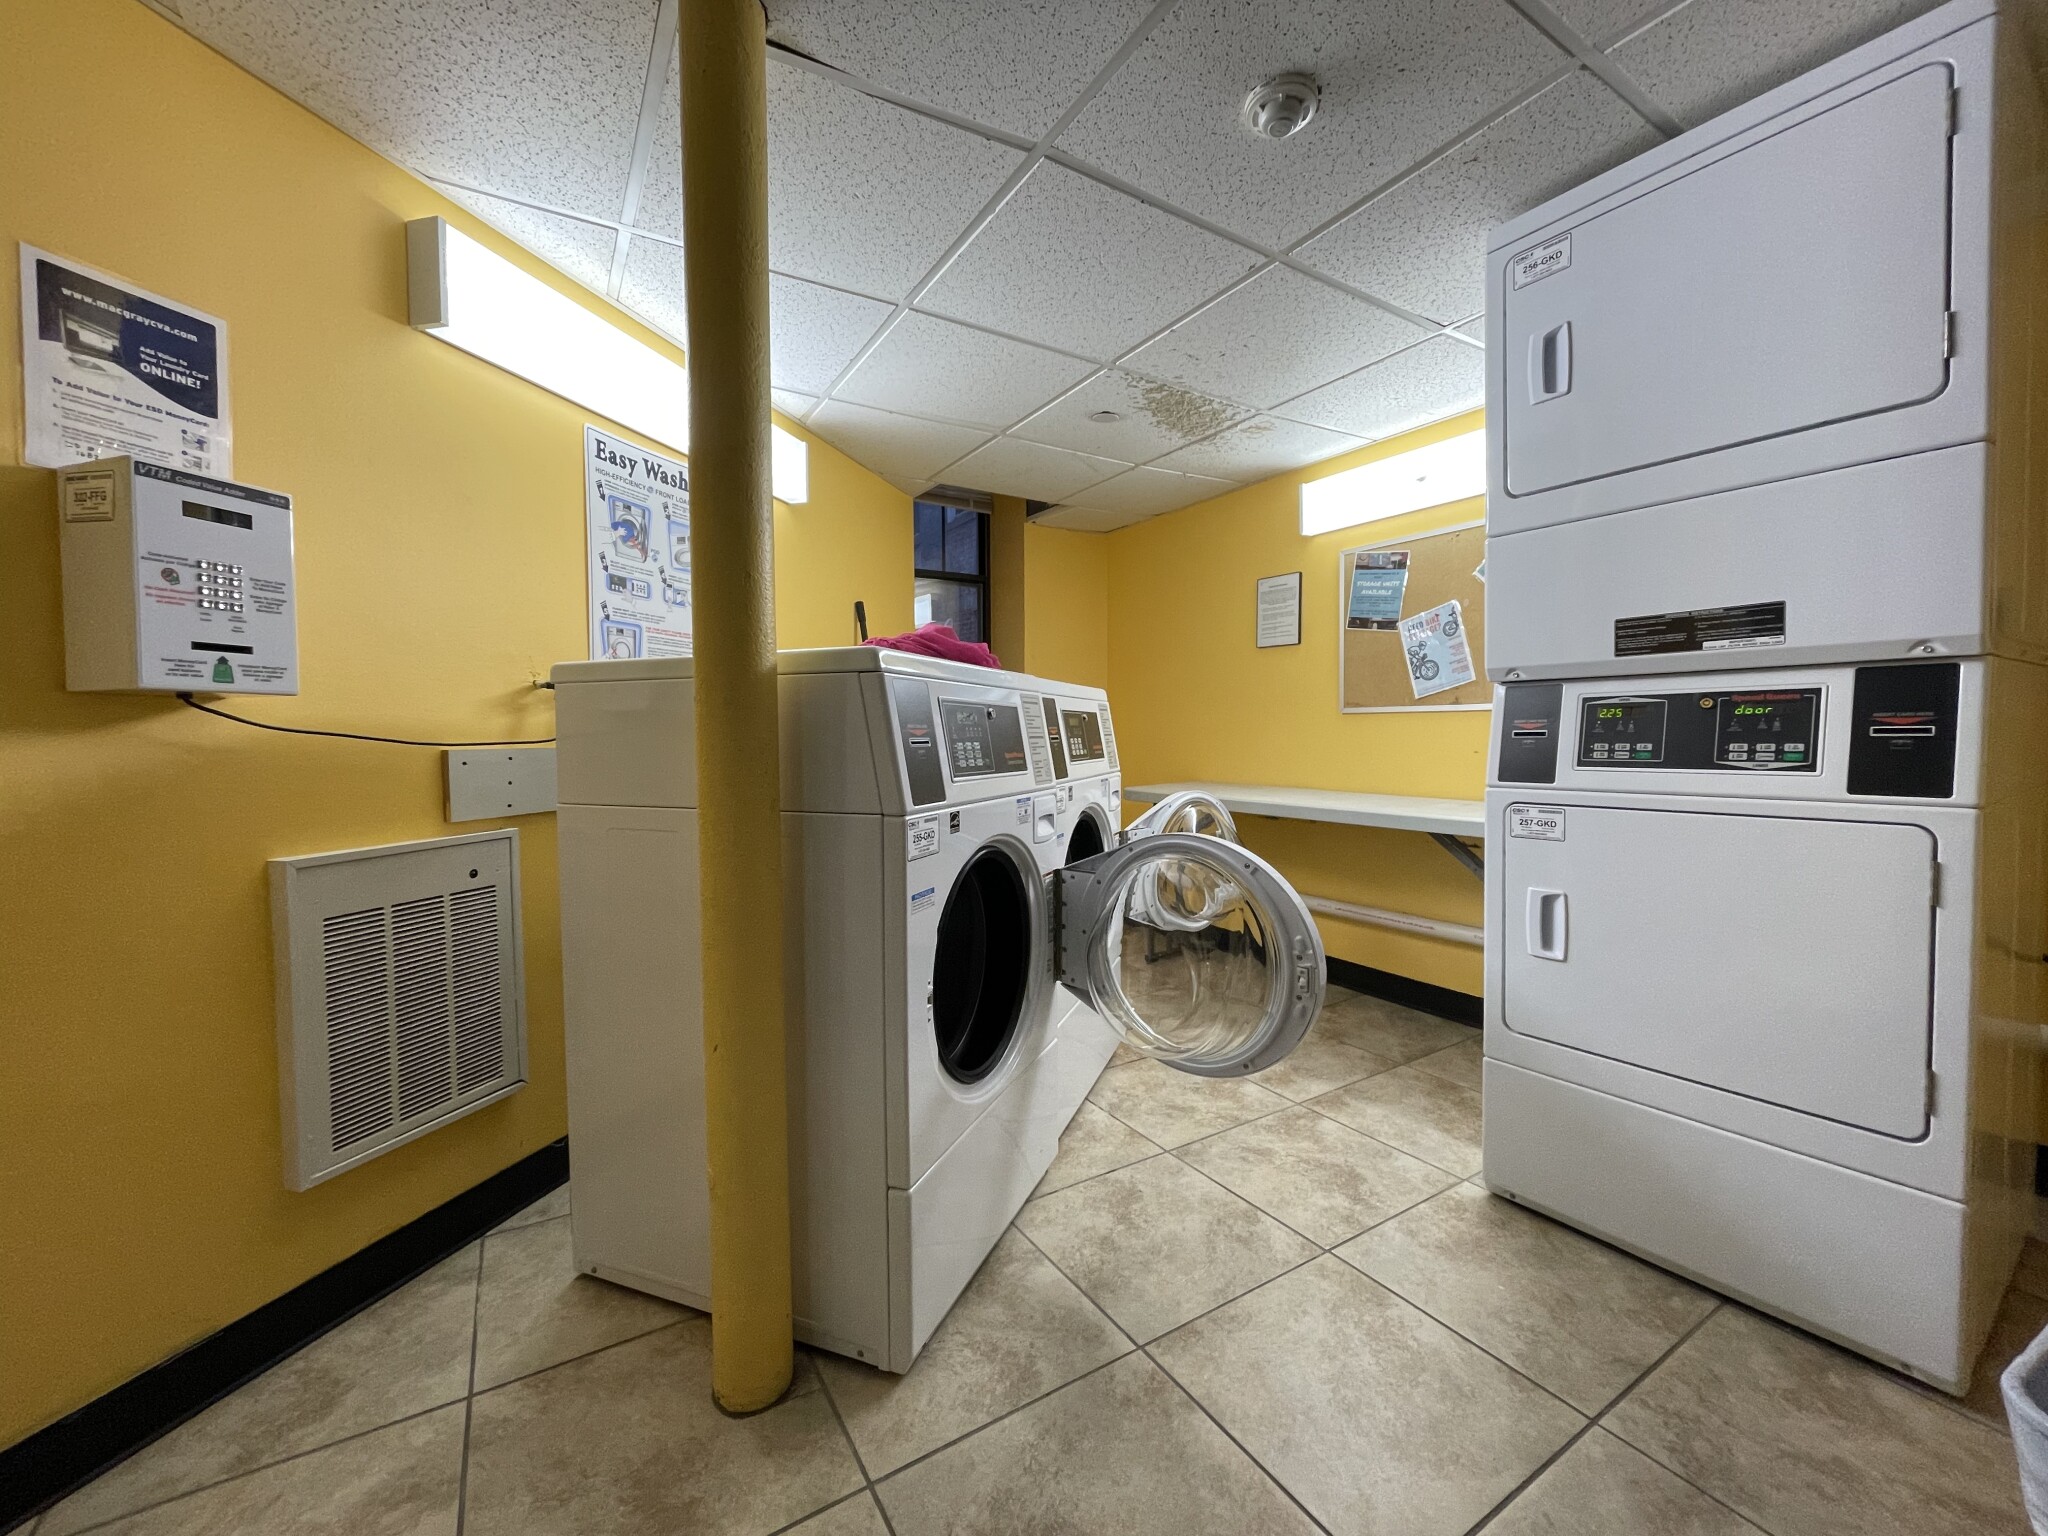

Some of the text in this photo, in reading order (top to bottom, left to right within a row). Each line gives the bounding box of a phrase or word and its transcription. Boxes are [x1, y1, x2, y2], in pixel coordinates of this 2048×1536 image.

[1522, 250, 1563, 274] 256-GKD
[61, 286, 198, 342] www.macgraycva.com
[139, 346, 188, 366] Add Value to
[140, 353, 209, 381] Your Laundry Card
[139, 363, 201, 390] ONLINE!
[52, 376, 210, 428] To Add Value to Your ESD MoneyCard:
[594, 438, 638, 478] Easy
[642, 457, 689, 492] Wash
[137, 463, 172, 481] VTM
[201, 481, 222, 493] Value
[223, 487, 247, 498] Adder
[595, 466, 647, 491] HIGH-EFFICIENCY
[655, 489, 675, 501] FRONT
[675, 495, 689, 505] LOA
[1424, 615, 1440, 626] BIKE
[1599, 707, 1623, 718] 2.25
[1734, 704, 1773, 716] door
[1519, 818, 1557, 828] 257-GKD
[912, 830, 936, 844] 255-GKD
